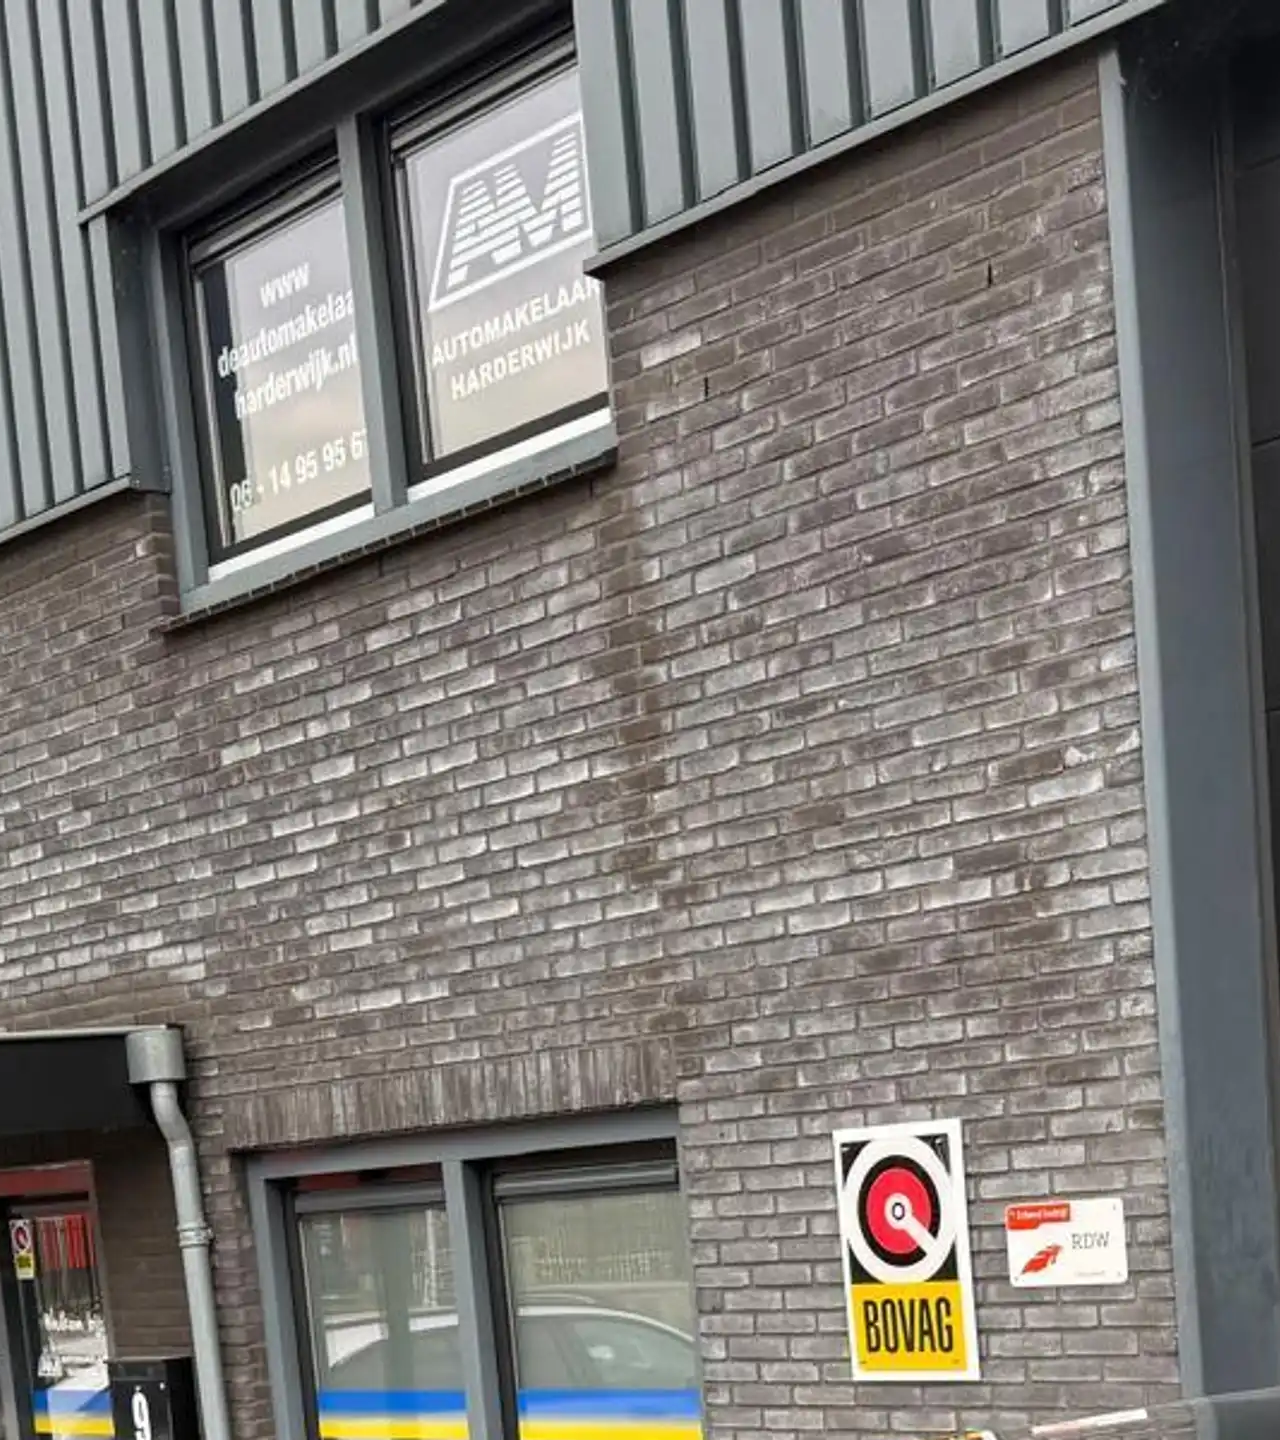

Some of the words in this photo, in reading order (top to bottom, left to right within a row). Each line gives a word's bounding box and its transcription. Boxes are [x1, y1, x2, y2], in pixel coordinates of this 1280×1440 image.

[260, 262, 310, 308] www
[431, 277, 600, 368] AUTOMAKELAAR
[234, 332, 358, 419] harderwijk.nl
[451, 319, 591, 401] HARDERWIJK
[269, 460, 292, 494] 14
[295, 450, 317, 484] 95
[323, 436, 346, 472] 95
[351, 427, 368, 460] 6
[1071, 1231, 1110, 1249] RDW
[863, 1296, 953, 1354] BOVAG
